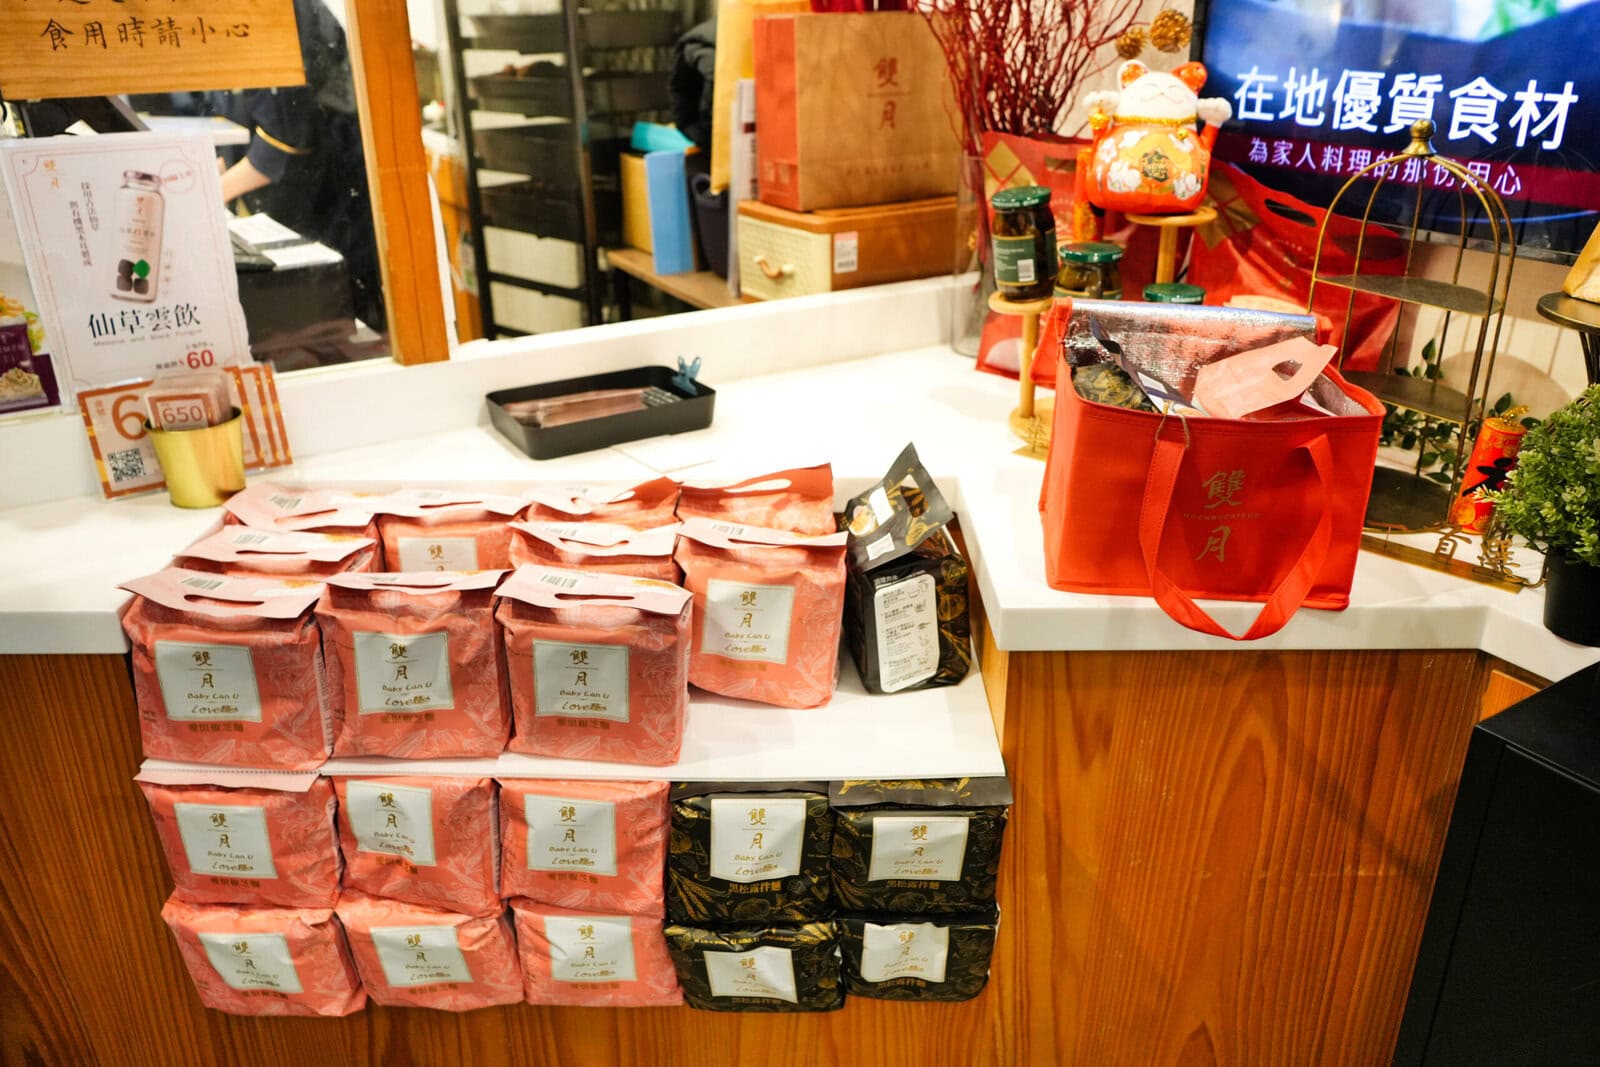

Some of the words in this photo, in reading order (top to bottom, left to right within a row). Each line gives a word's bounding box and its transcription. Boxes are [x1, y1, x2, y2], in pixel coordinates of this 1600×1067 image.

[41, 17, 251, 50] 食用時請小心
[1232, 64, 1580, 151] 在地優質食材
[1248, 137, 1523, 196] 為家人料理的那份用心
[88, 303, 201, 339] 仙草雲飲
[162, 405, 203, 424] 650
[1194, 469, 1247, 563] 雙月
[739, 591, 757, 628] 雙月
[192, 651, 215, 688] 雙月
[389, 643, 408, 680] 雙月
[569, 650, 589, 686] 雙月
[377, 792, 397, 828] 雙月
[558, 806, 577, 842] 雙月
[209, 813, 231, 848] 雙月
[748, 808, 767, 849] 雙月
[577, 925, 595, 959] 雙月
